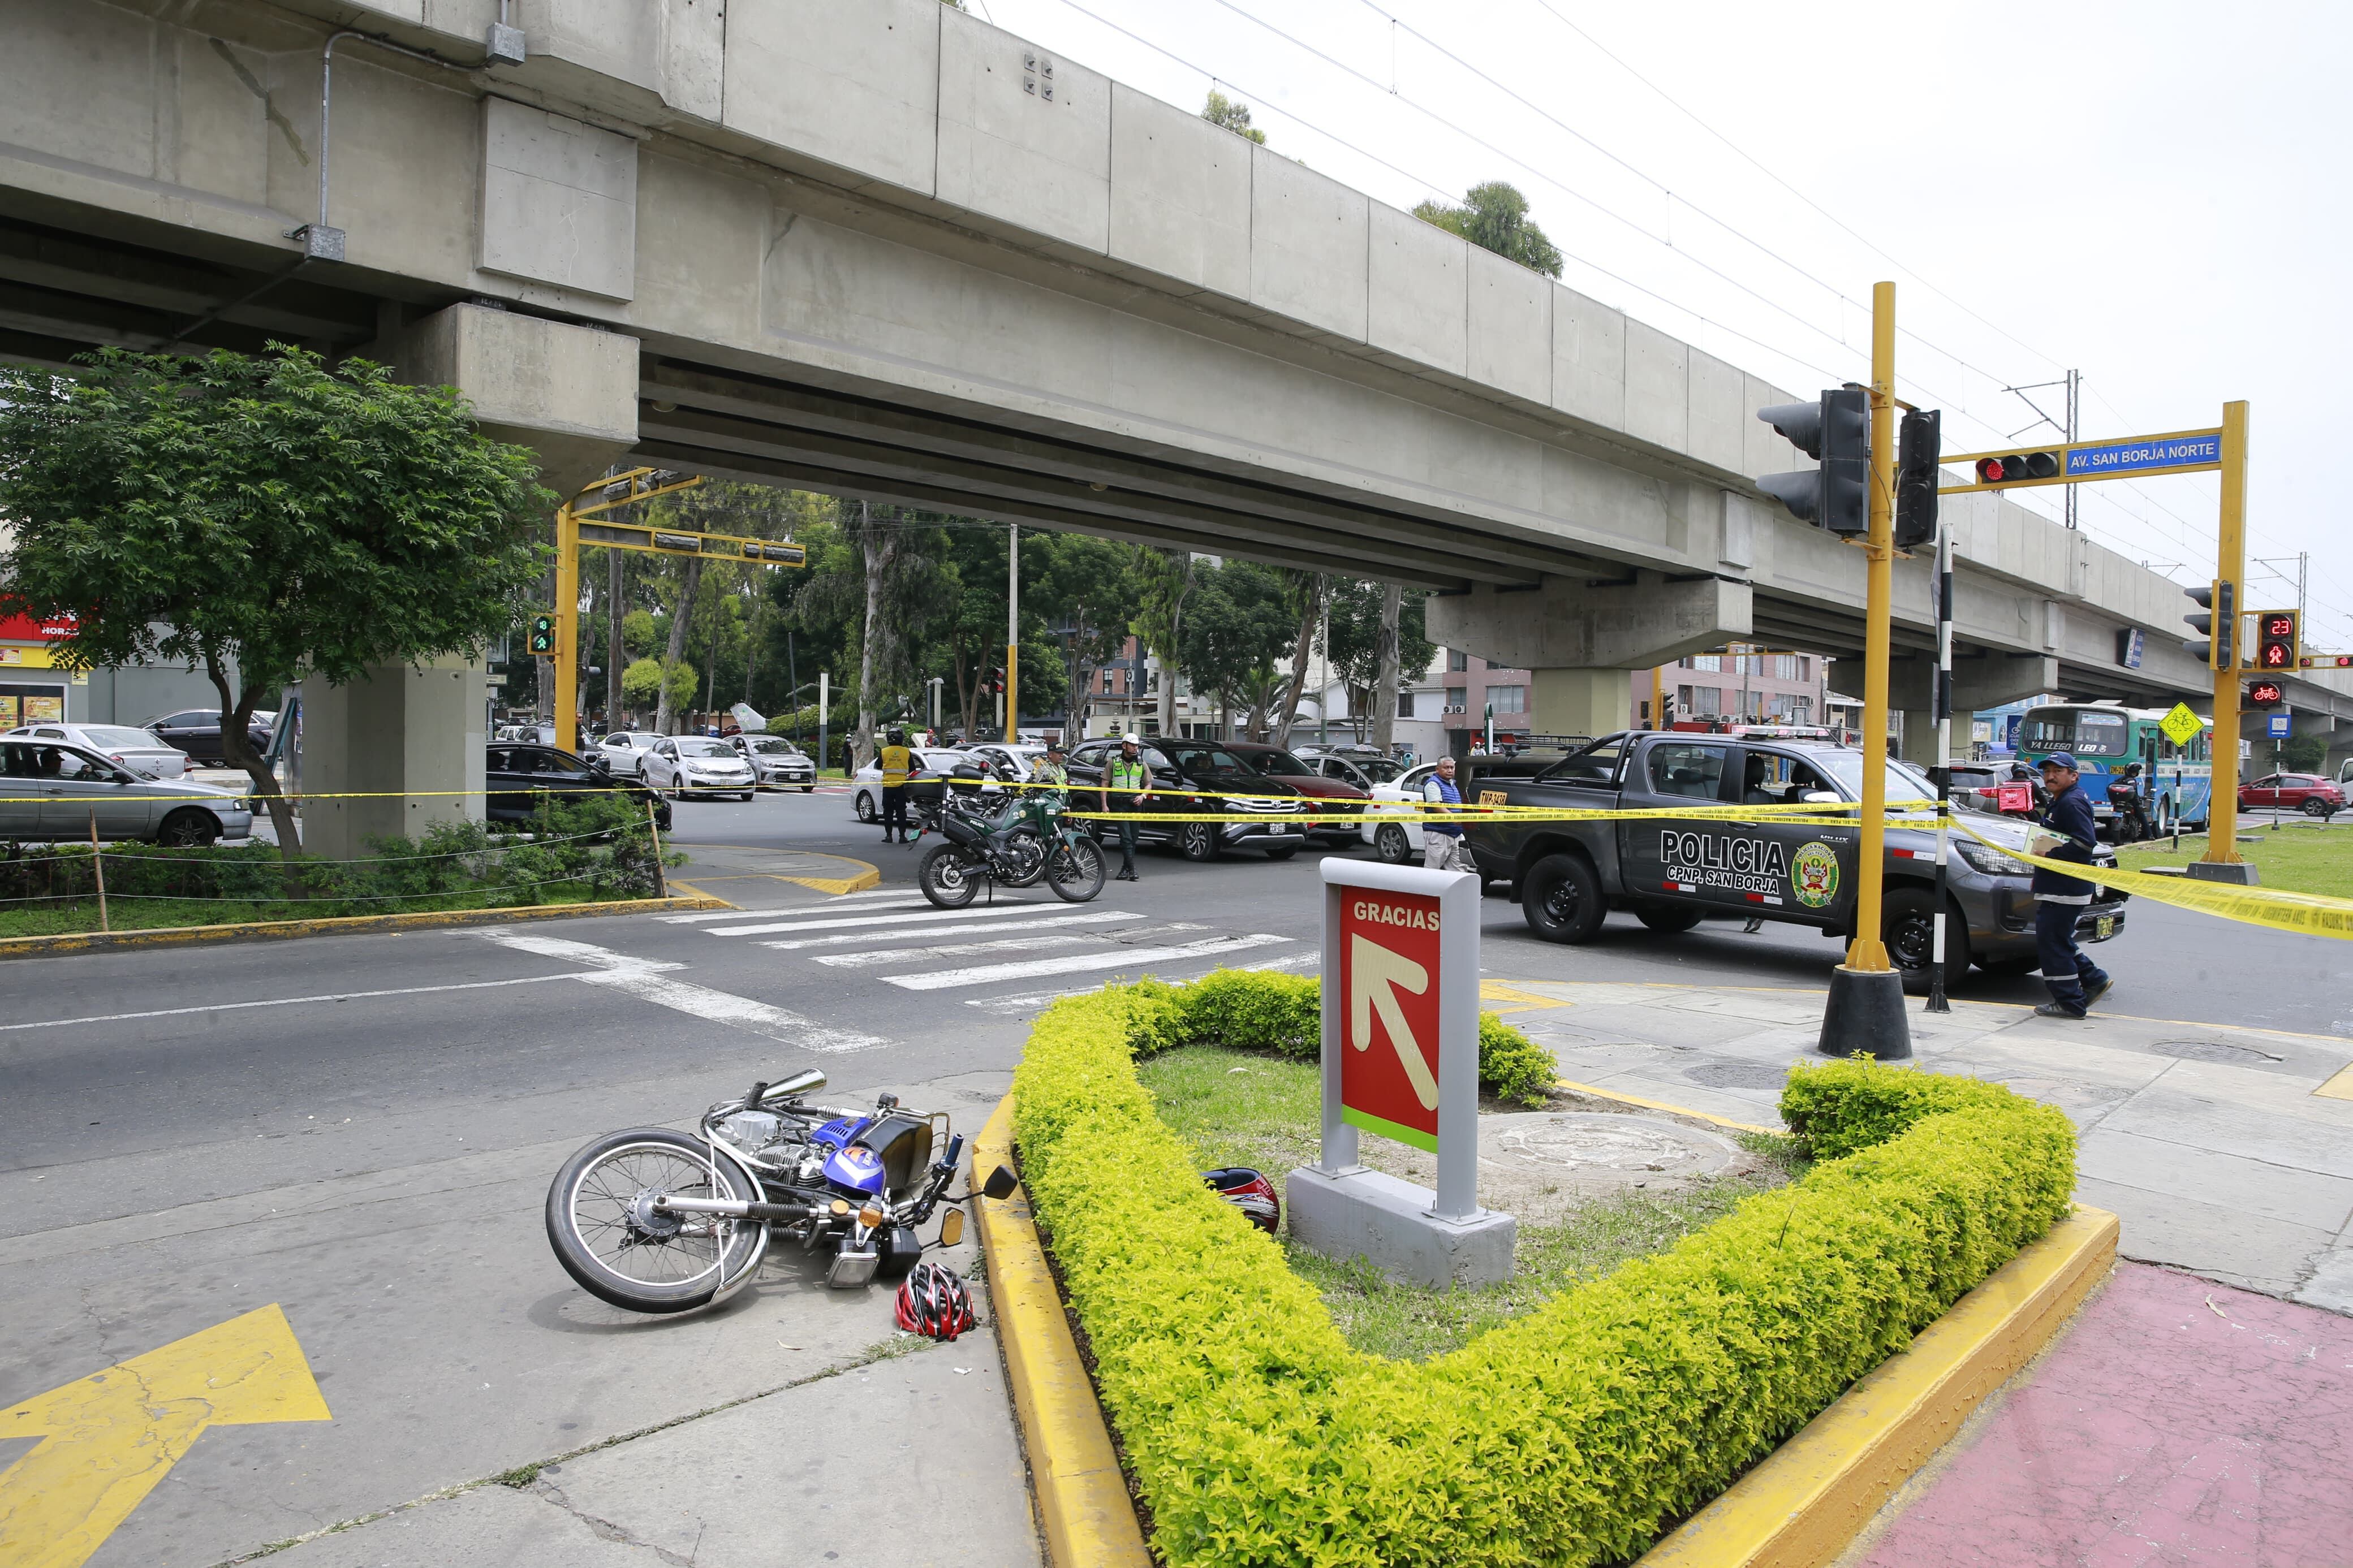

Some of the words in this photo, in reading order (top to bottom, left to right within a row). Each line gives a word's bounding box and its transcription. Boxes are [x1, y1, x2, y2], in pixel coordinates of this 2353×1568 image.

[2071, 455, 2089, 468] AV.
[2092, 452, 2118, 466] SAN
[2122, 448, 2165, 463] BORJA
[2169, 443, 2214, 459] NORTE
[539, 620, 547, 630] 18
[2272, 620, 2289, 634] 23
[2043, 741, 2072, 750] LLEGO
[2078, 744, 2097, 752] LEO
[1481, 793, 1506, 806] TMP-3438
[1660, 830, 1788, 878] POLICIA
[1797, 844, 1813, 859] POLICIA
[1813, 844, 1835, 863] NACIONAL
[1667, 865, 1704, 884] CPNP.
[1705, 870, 1733, 888] SAN
[1734, 874, 1779, 895] BORJA
[1354, 901, 1440, 931] GRACIAS
